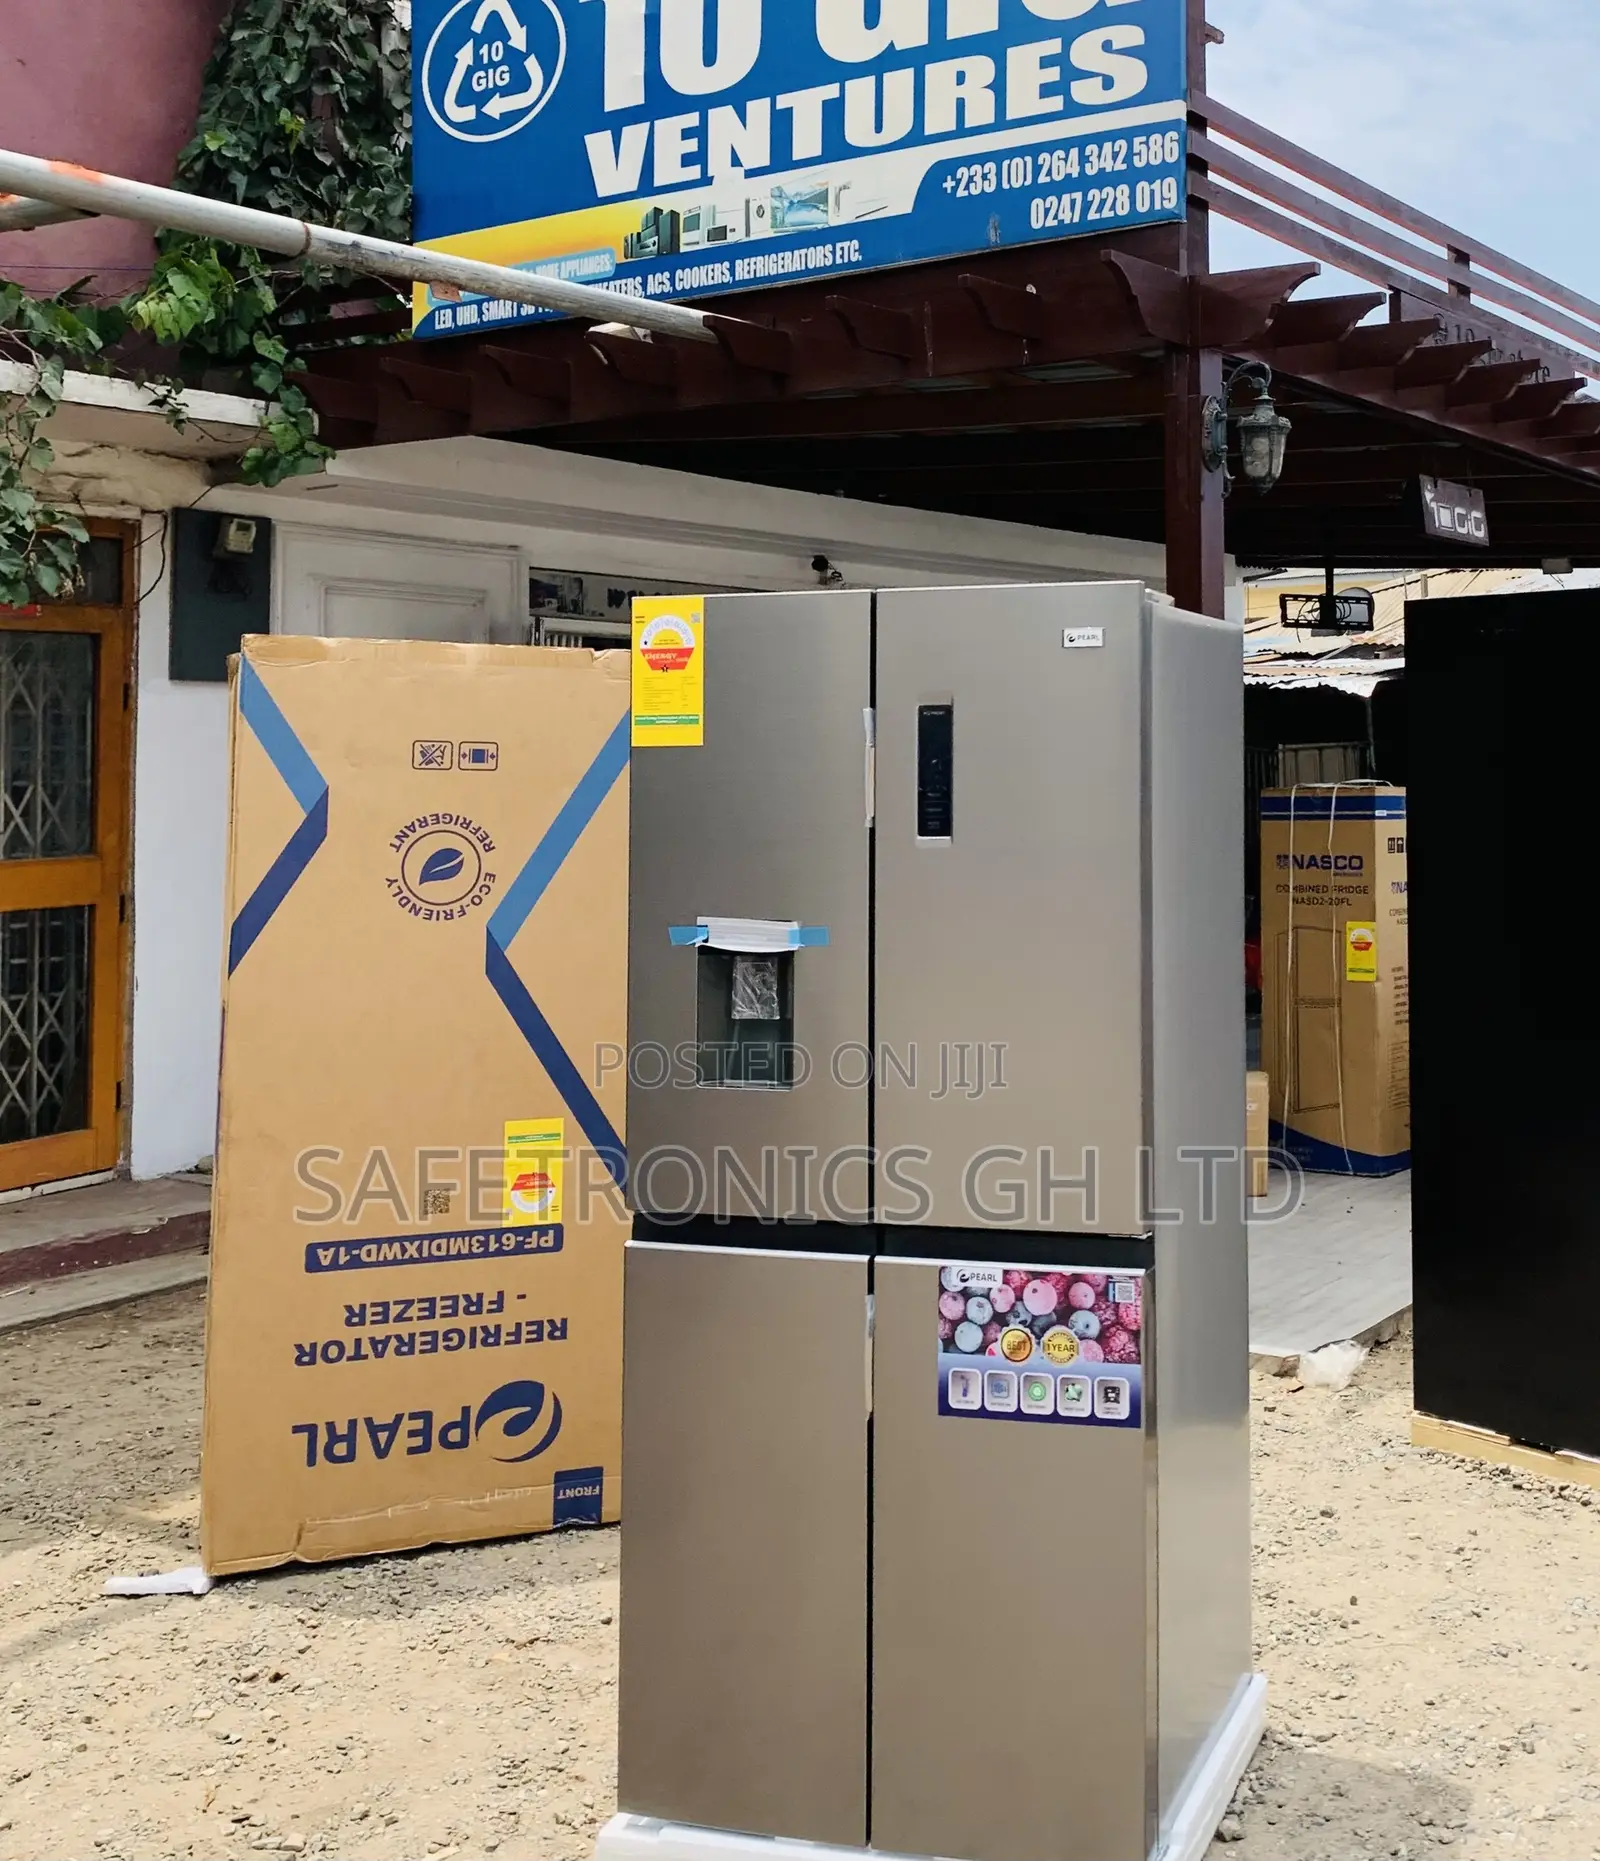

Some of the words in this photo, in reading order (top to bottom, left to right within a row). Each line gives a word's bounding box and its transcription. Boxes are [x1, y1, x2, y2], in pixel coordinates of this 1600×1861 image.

[478, 40, 504, 65] 10
[580, 0, 763, 113] 10
[471, 65, 511, 92] GIG
[584, 24, 1148, 198] VENTURES
[942, 161, 998, 199] +233
[1001, 156, 1033, 191] (0)
[1037, 147, 1081, 184] 264
[1084, 138, 1128, 175] 342
[1132, 130, 1180, 166] 586
[1029, 193, 1082, 230] 0247
[1086, 186, 1131, 222] 228
[1134, 177, 1179, 211] 019
[646, 271, 673, 295] ACS,
[675, 263, 733, 292] COOKERS,
[735, 247, 833, 281] REFRIGERATORS
[835, 240, 862, 267] ETC.
[434, 308, 455, 330] LED,
[456, 304, 480, 326] UHD,
[482, 298, 518, 322] SMART
[389, 813, 496, 853] REFRIGERANT
[1291, 854, 1364, 871] NASCO
[385, 872, 497, 921] ECO-FRIENDLY
[317, 1228, 555, 1266] PF-613MDIXWD-1A
[970, 1273, 998, 1283] PEARL
[343, 1291, 505, 1327] FREEZER
[294, 1317, 569, 1367] REFRIGERATOR
[1051, 1344, 1075, 1353] YEAR
[291, 1405, 472, 1468] PEARL
[557, 1485, 600, 1500] FRONT
